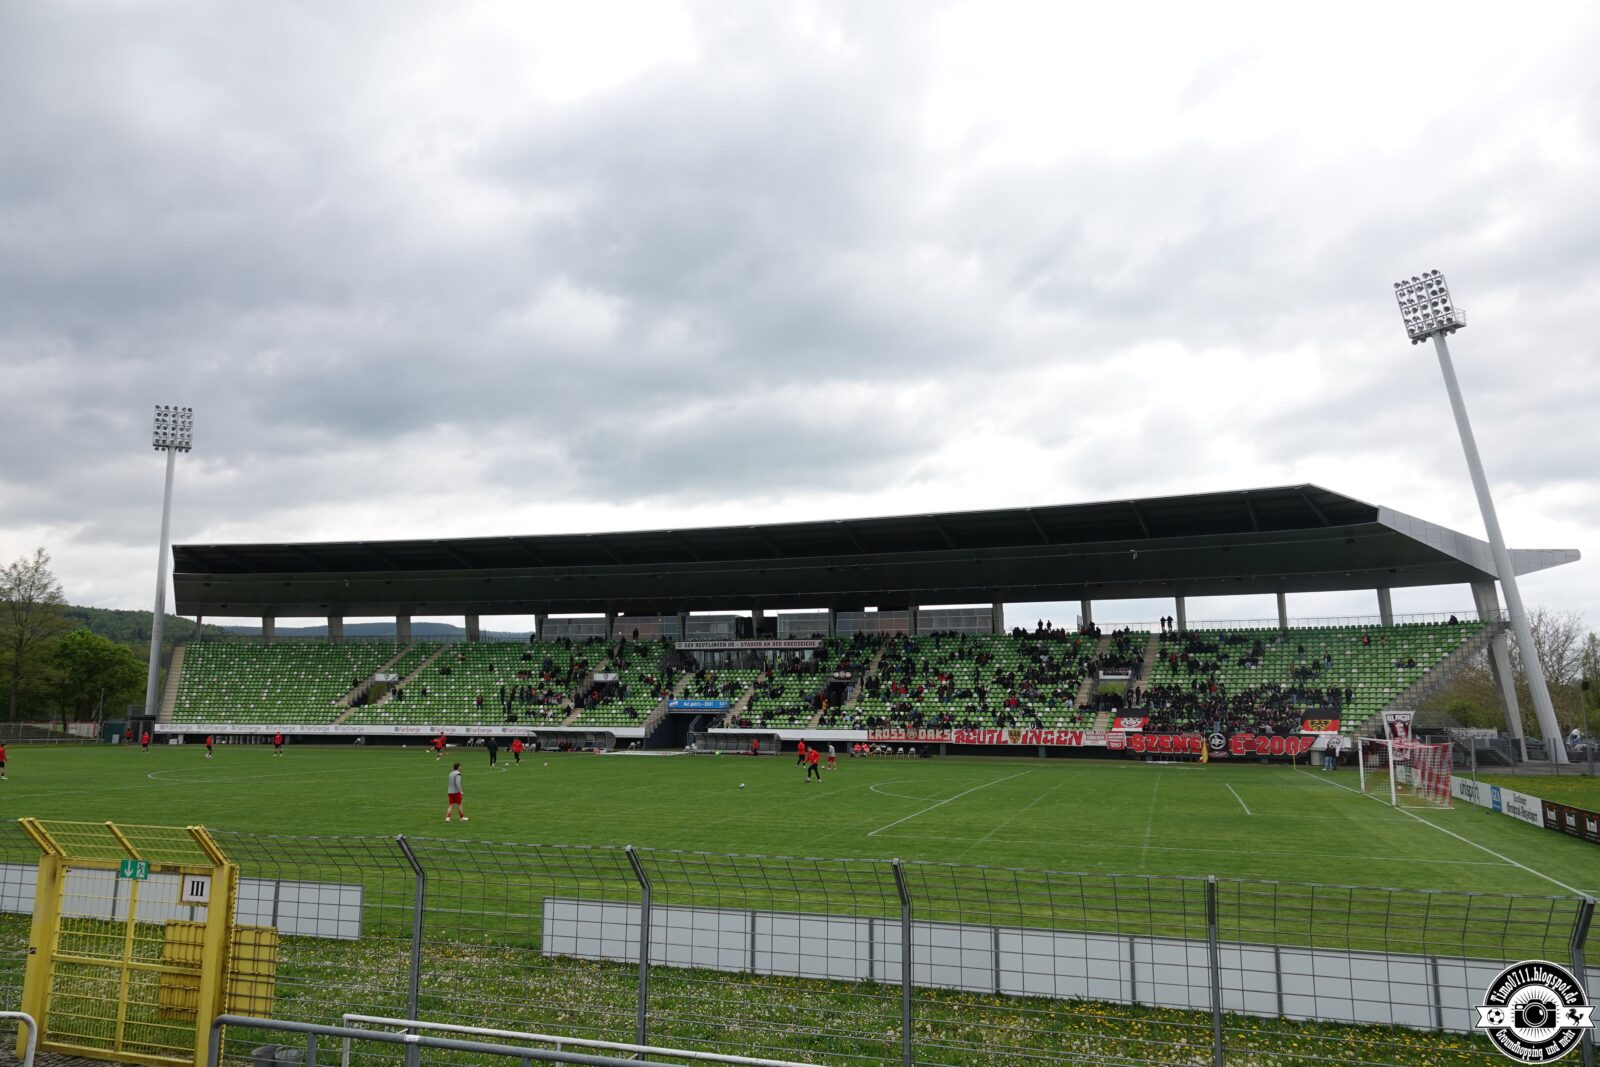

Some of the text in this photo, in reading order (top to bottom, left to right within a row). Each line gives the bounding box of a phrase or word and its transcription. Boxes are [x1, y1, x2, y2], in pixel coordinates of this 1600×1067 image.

[868, 728, 951, 740] CROSS OAKS
[1132, 733, 1202, 754] SZENE
[190, 881, 204, 896] III
